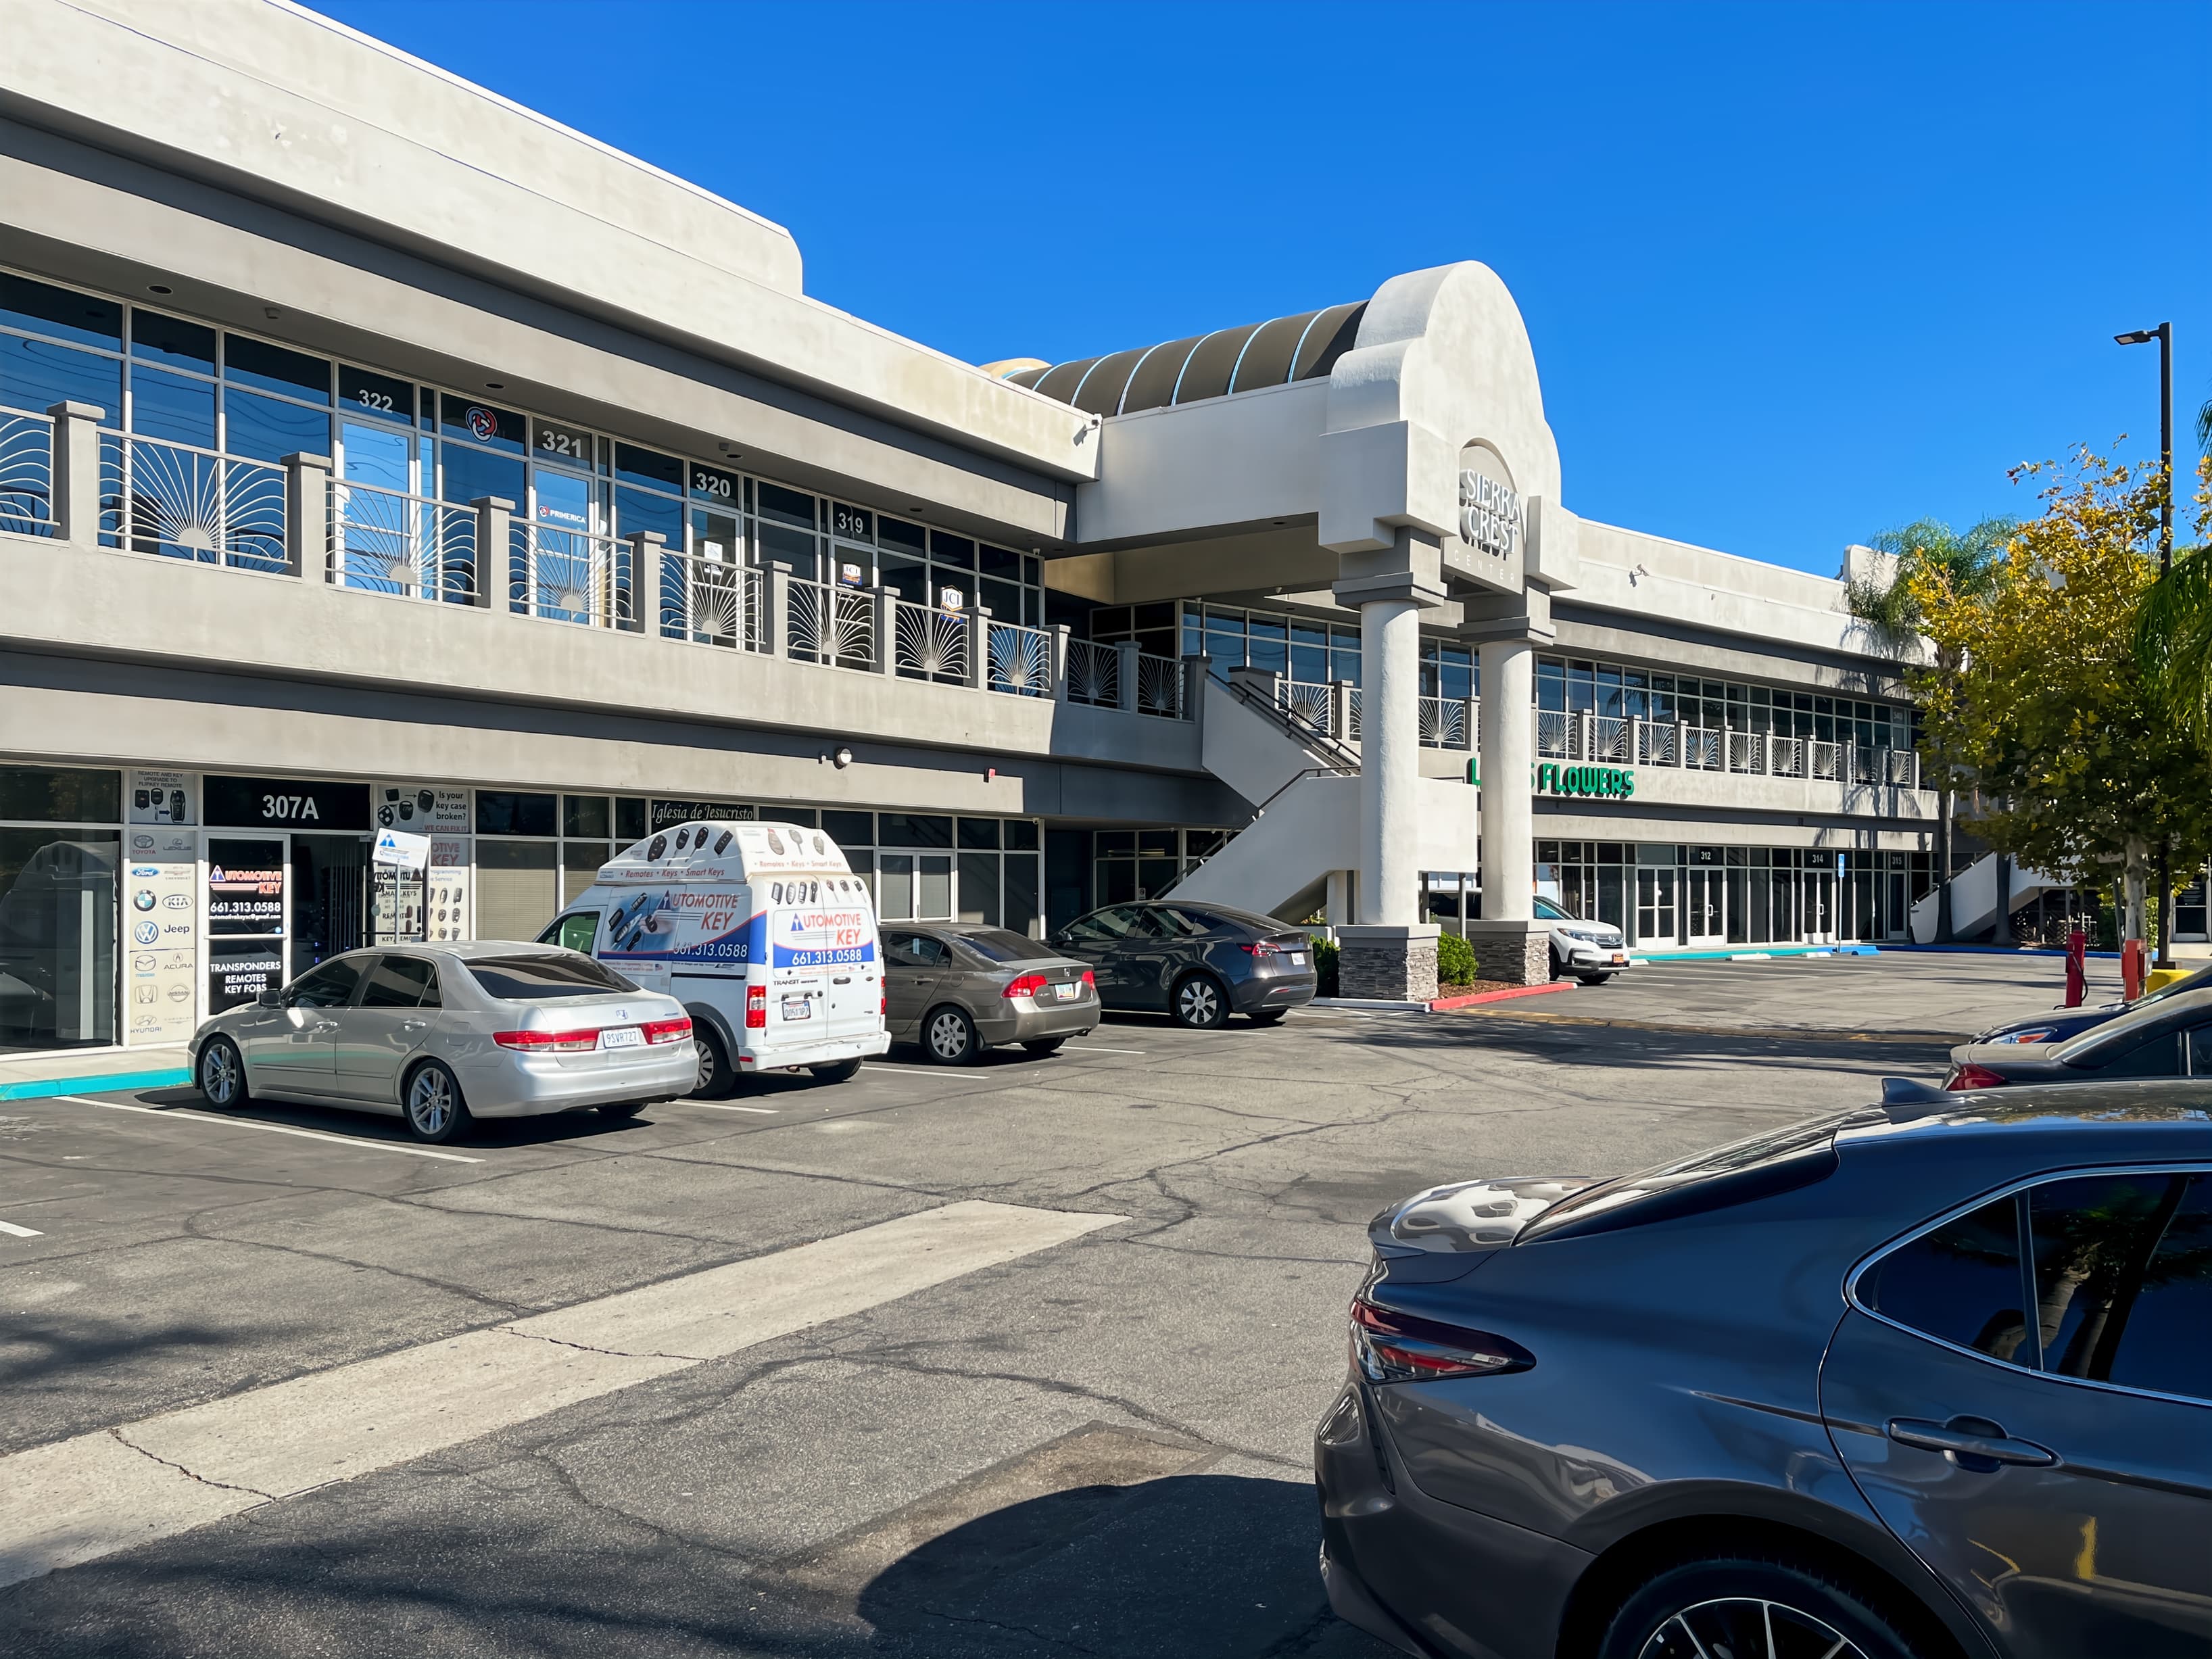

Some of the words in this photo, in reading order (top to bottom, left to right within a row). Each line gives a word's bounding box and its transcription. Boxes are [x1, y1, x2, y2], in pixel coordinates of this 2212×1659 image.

[359, 389, 393, 414] 322
[542, 430, 581, 458] 321
[696, 472, 731, 498] 320
[1466, 469, 1520, 523] SIERRA
[550, 509, 587, 524] PRIMERICA
[838, 512, 863, 534] 319
[1467, 506, 1518, 554] CREST
[1454, 550, 1514, 583] CENTER
[943, 591, 960, 606] JCI
[1542, 763, 1635, 796] FLOWERS
[439, 790, 445, 798] Is
[262, 794, 319, 819] 307A
[436, 801, 449, 811] key
[652, 802, 688, 823] Iglesia
[690, 804, 702, 819] de
[703, 804, 753, 820] Jesucristo
[1701, 851, 1711, 860] 312
[1812, 854, 1823, 863] 314
[625, 870, 654, 878] Remotes
[662, 869, 677, 879] Keys
[686, 868, 706, 876] Smart
[708, 867, 725, 877] Keys
[258, 882, 282, 894] KEY
[168, 898, 188, 906] KIA
[210, 902, 281, 913] 661.313.0588
[701, 911, 734, 931] KEY
[164, 924, 190, 934] Jeep
[836, 929, 861, 945] KEY
[673, 942, 748, 957] 661.313.0588
[792, 948, 862, 965] 661.313.0588
[210, 961, 281, 972] TRANSPONDERS
[225, 973, 267, 984] REMOTES
[773, 978, 800, 986] TRANSIT
[225, 984, 242, 994] KEY
[243, 984, 267, 993] FOBS
